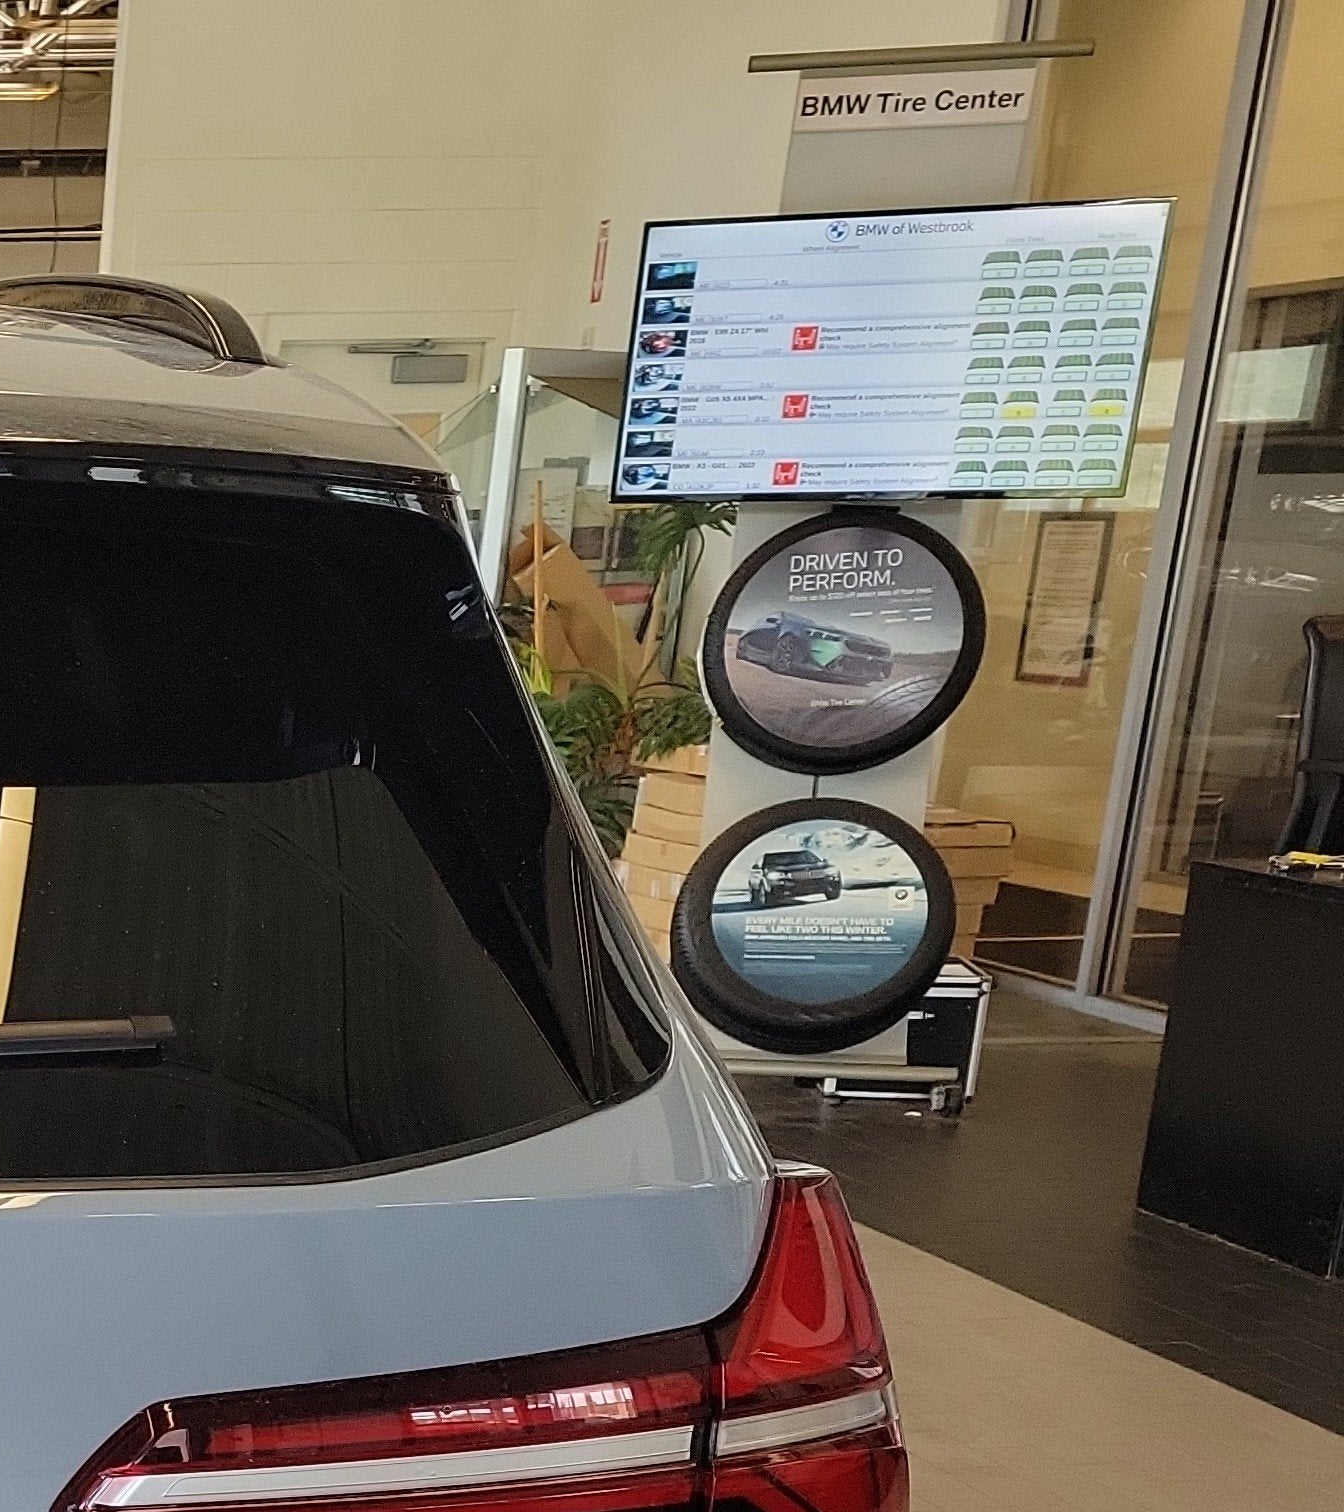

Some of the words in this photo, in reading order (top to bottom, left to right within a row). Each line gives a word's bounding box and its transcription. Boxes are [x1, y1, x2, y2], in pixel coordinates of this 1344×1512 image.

[800, 93, 872, 117] BMW
[877, 91, 926, 114] Tire
[934, 89, 1025, 111] Center
[855, 223, 890, 236] BMW
[892, 222, 906, 235] of
[908, 220, 975, 234] Westbrook
[790, 551, 868, 573] DRIVEN
[873, 548, 904, 567] TO
[788, 569, 896, 593] PERFORM.
[745, 925, 768, 933] FEEL
[771, 926, 792, 934] LIKE
[796, 926, 818, 934] TWO
[821, 926, 844, 934] THIS
[845, 926, 888, 934] WINTER.
[746, 917, 778, 925] EVERY
[881, 918, 894, 926] TO
